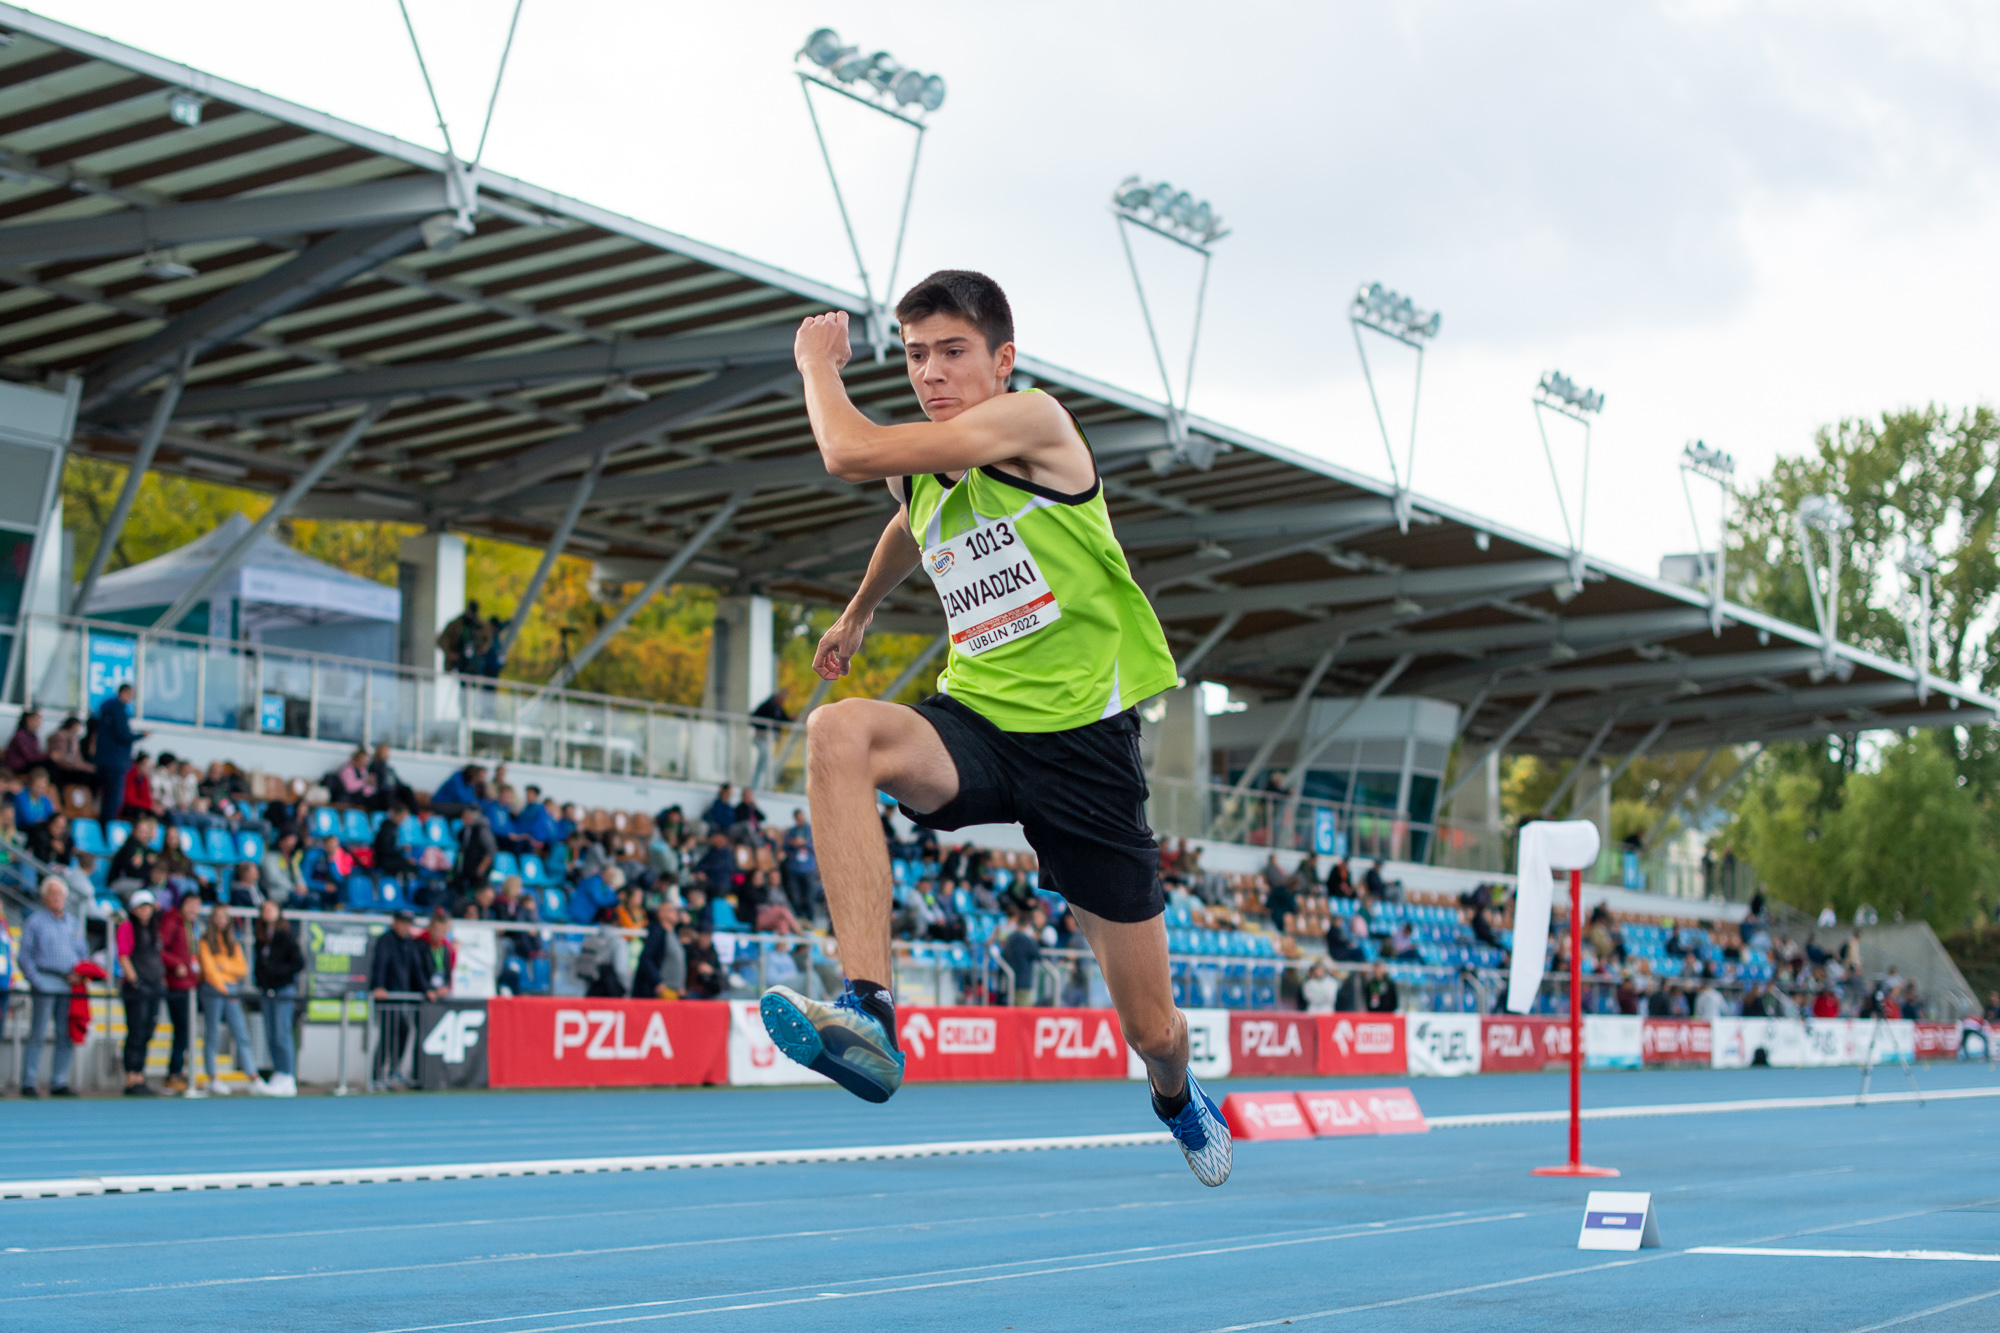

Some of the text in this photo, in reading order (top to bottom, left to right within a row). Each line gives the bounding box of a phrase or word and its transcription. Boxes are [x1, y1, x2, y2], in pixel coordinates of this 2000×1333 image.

[965, 522, 1015, 561] 1013
[934, 555, 951, 570] LOTTO
[942, 559, 1037, 619] ZAWADZKI
[968, 614, 1041, 652] LUBLIN 2022
[423, 1009, 486, 1064] 4F
[553, 1009, 674, 1060] PZLA
[1033, 1016, 1118, 1059] PZLA
[1240, 1020, 1303, 1057] PZLA
[1487, 1024, 1535, 1058] PZLA
[1308, 1098, 1371, 1127] PZLA
